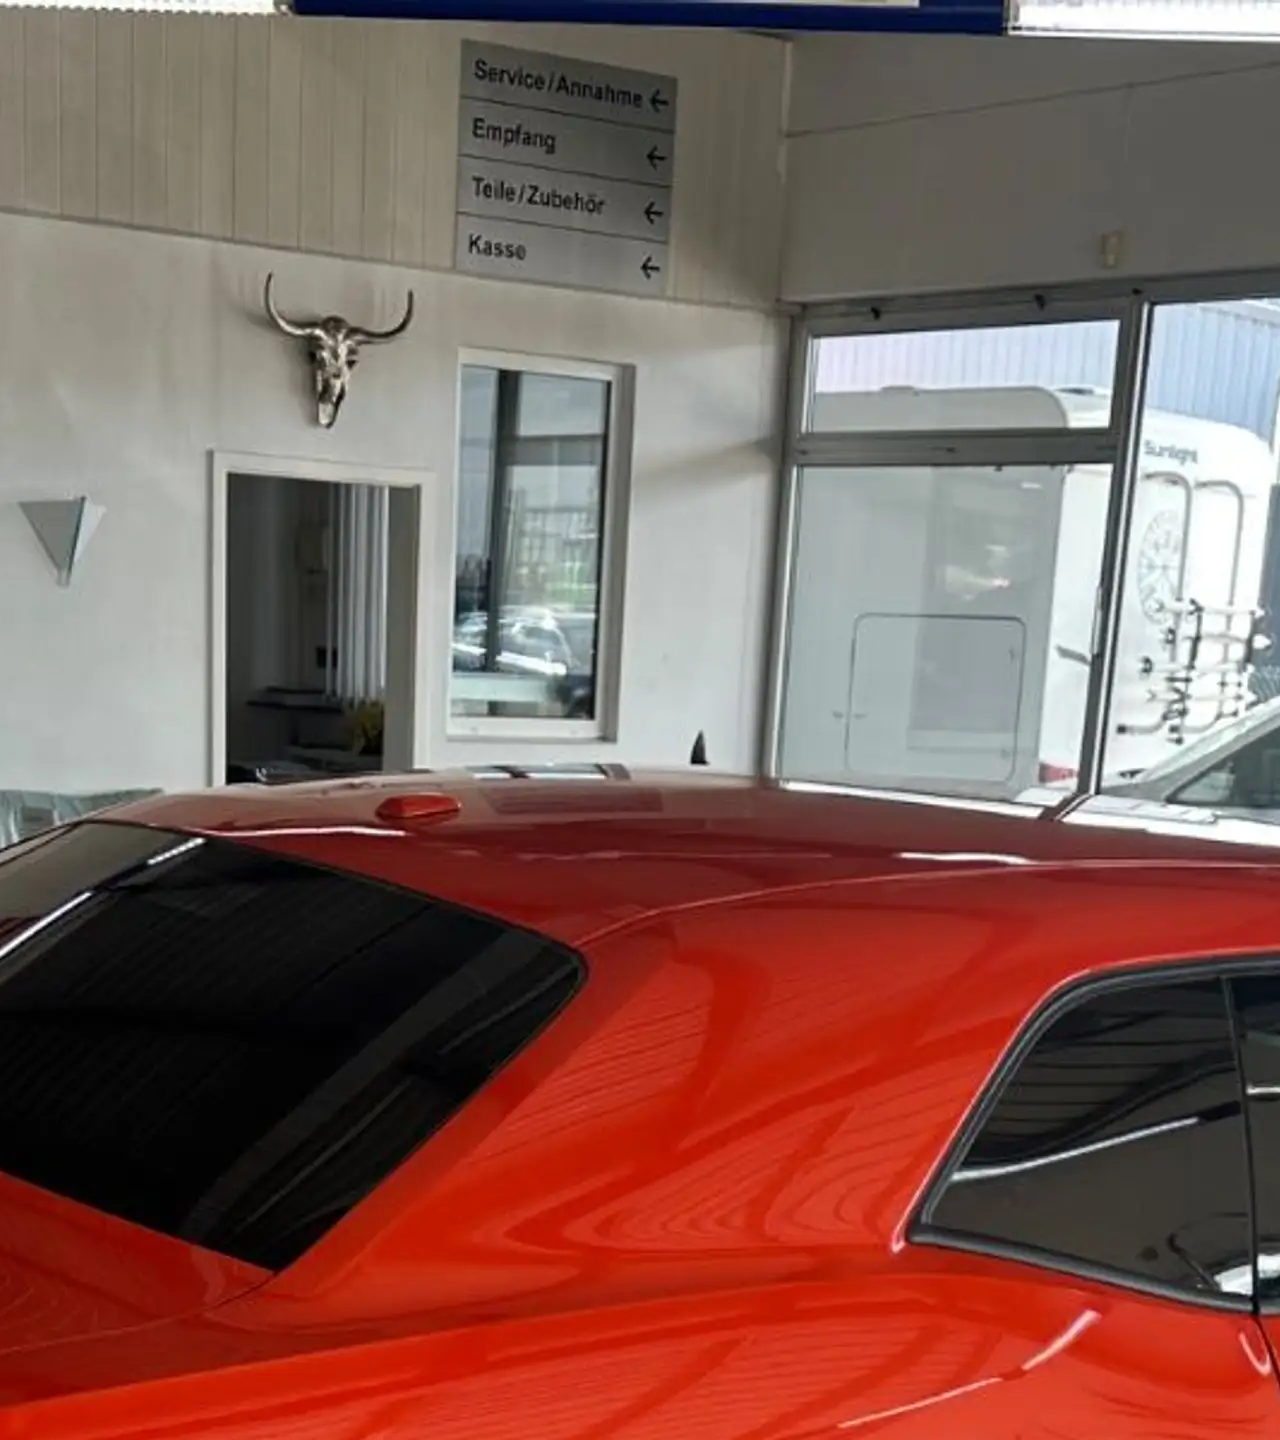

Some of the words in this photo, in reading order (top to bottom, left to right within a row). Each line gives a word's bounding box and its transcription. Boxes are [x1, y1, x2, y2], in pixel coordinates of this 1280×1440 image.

[474, 58, 643, 107] Service/Annahme
[472, 117, 557, 155] Empfang
[472, 175, 606, 215] Teile/Zubehör
[468, 233, 527, 261] Kasse
